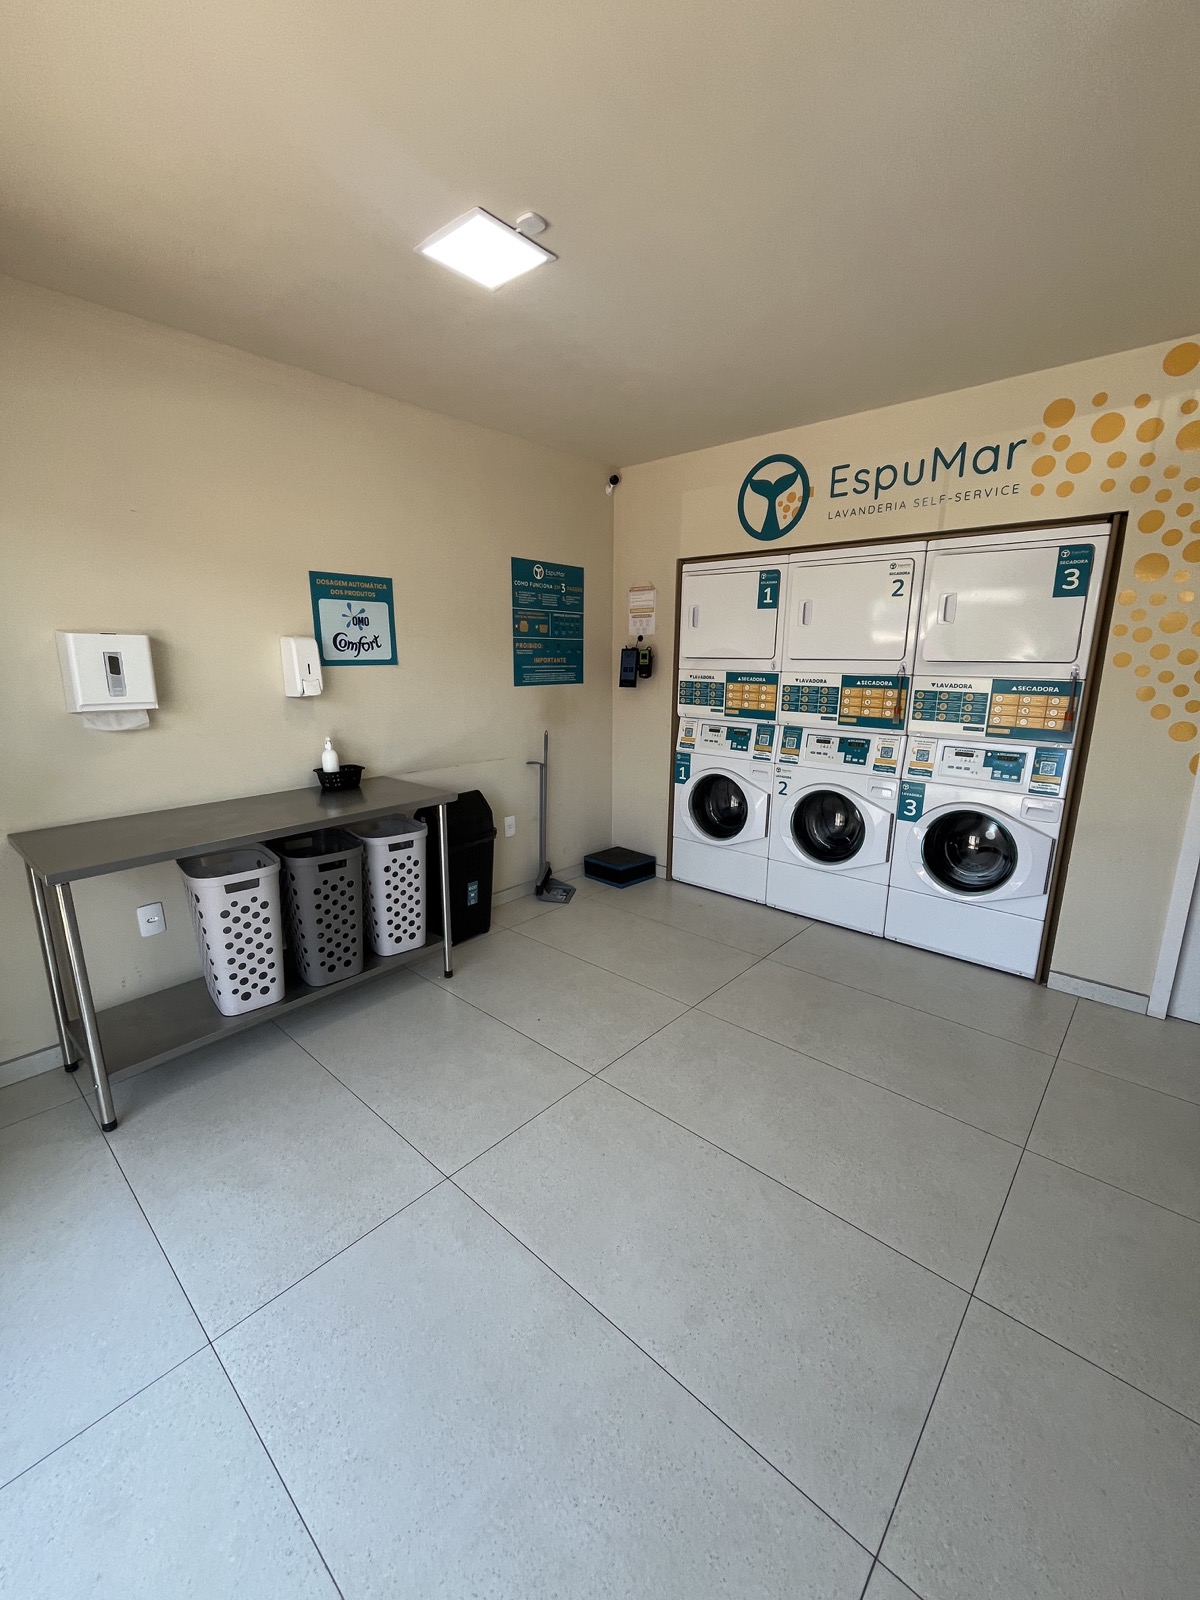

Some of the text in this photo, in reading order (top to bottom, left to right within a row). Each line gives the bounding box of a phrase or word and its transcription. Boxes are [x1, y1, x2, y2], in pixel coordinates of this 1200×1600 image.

[830, 438, 1028, 500] EspuMar
[828, 483, 1021, 520] LAVANDERIA SELF-SERVICE
[546, 569, 566, 578] EspuMar
[1062, 568, 1080, 590] 3
[316, 578, 387, 590] DOSAGEM AUTOMÁTICA
[561, 583, 566, 593] 3
[892, 578, 904, 597] 2
[344, 590, 376, 598] PRODUTOS
[764, 587, 772, 603] 1
[352, 616, 370, 627] OMO
[332, 632, 382, 658] Comfort
[679, 766, 686, 780] 1
[778, 781, 788, 796] 2
[903, 799, 917, 816] 3
